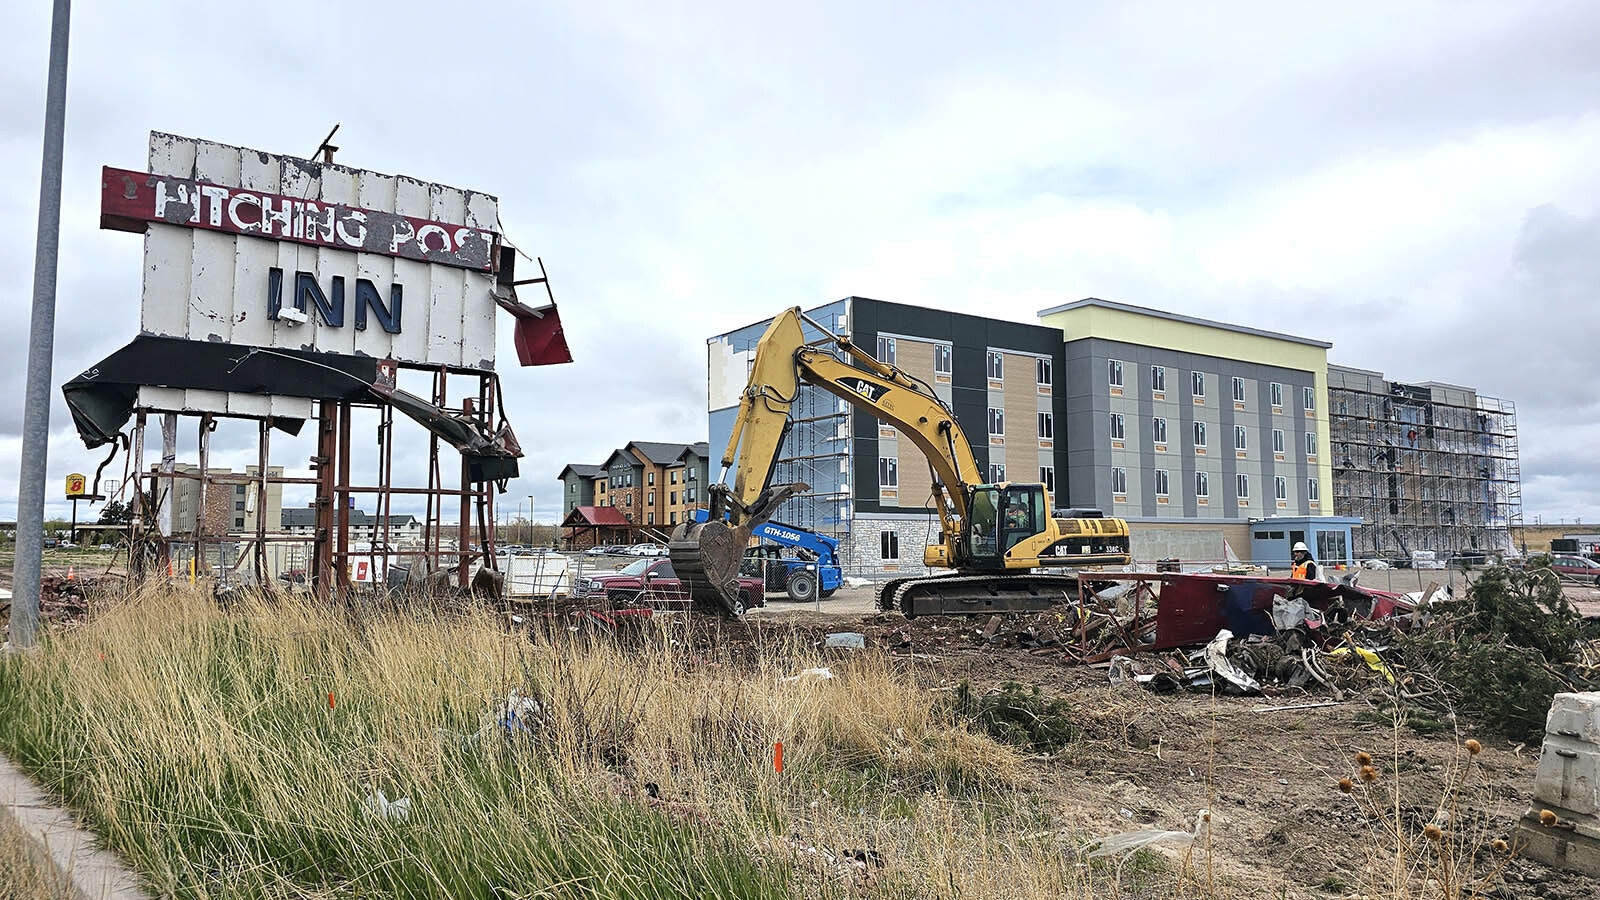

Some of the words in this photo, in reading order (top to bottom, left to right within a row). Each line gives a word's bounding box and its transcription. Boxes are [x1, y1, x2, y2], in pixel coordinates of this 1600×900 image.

[155, 180, 367, 247] HITCHING
[267, 266, 403, 334] INN
[856, 380, 875, 400] CAT
[71, 480, 82, 492] 8
[764, 526, 801, 542] GTH-1056
[1055, 545, 1068, 556] CAT
